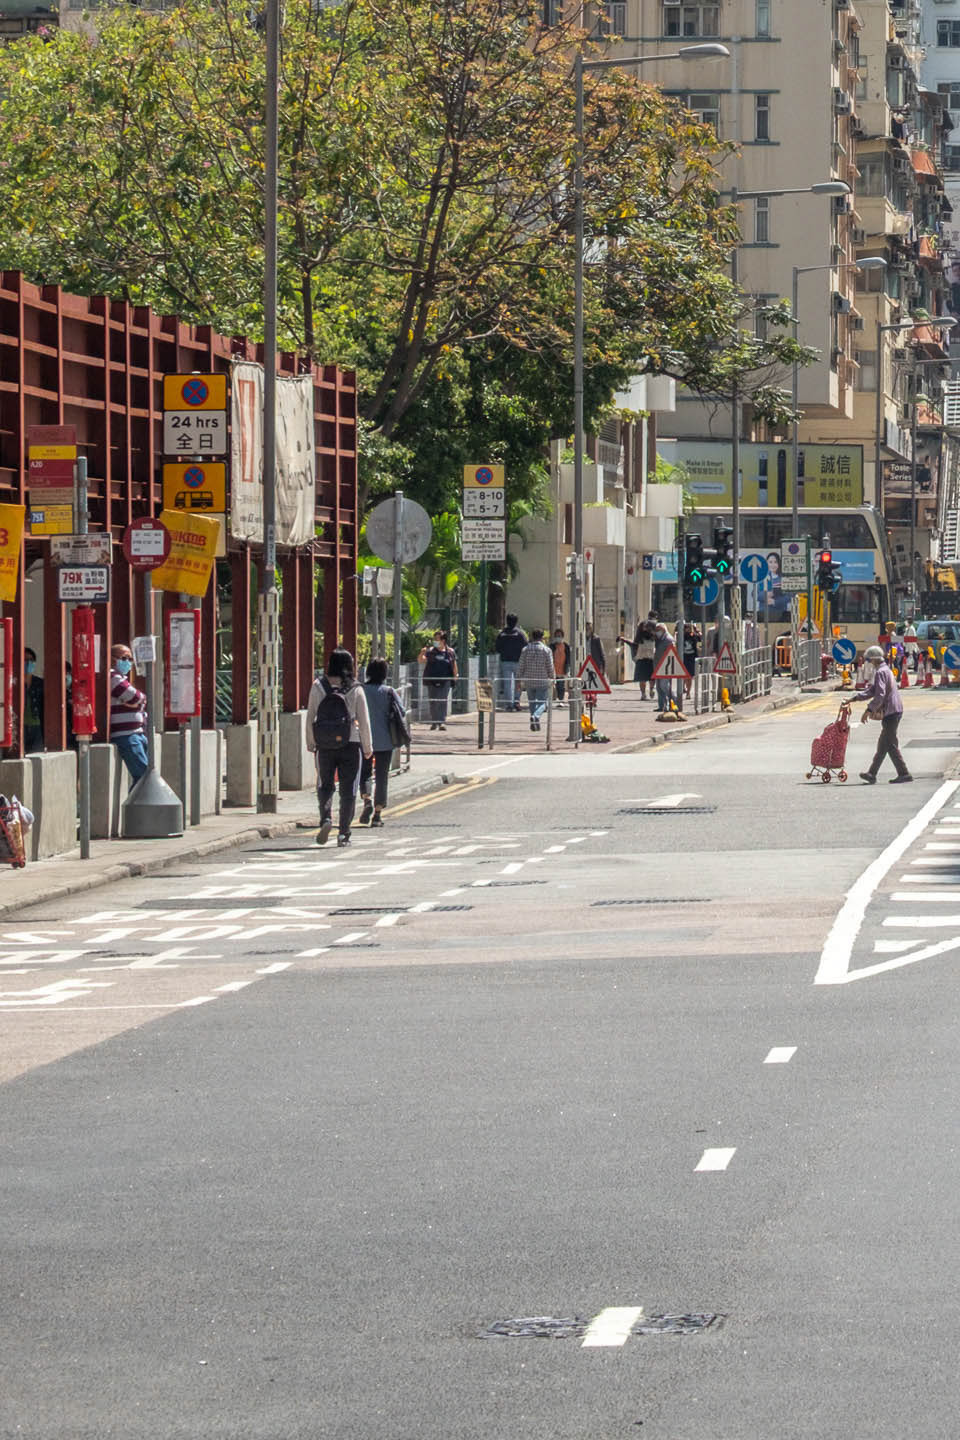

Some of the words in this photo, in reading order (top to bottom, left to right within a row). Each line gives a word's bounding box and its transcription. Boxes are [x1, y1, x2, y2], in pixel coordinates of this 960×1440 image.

[171, 416, 191, 428] 24
[196, 416, 218, 428] hrs
[176, 433, 213, 450] 全日
[820, 455, 851, 475] 誠信
[479, 492, 502, 500] 8-10
[62, 572, 83, 585] 79X
[248, 844, 521, 861] STOP
[66, 905, 346, 924] BUS
[0, 924, 332, 945] STOP
